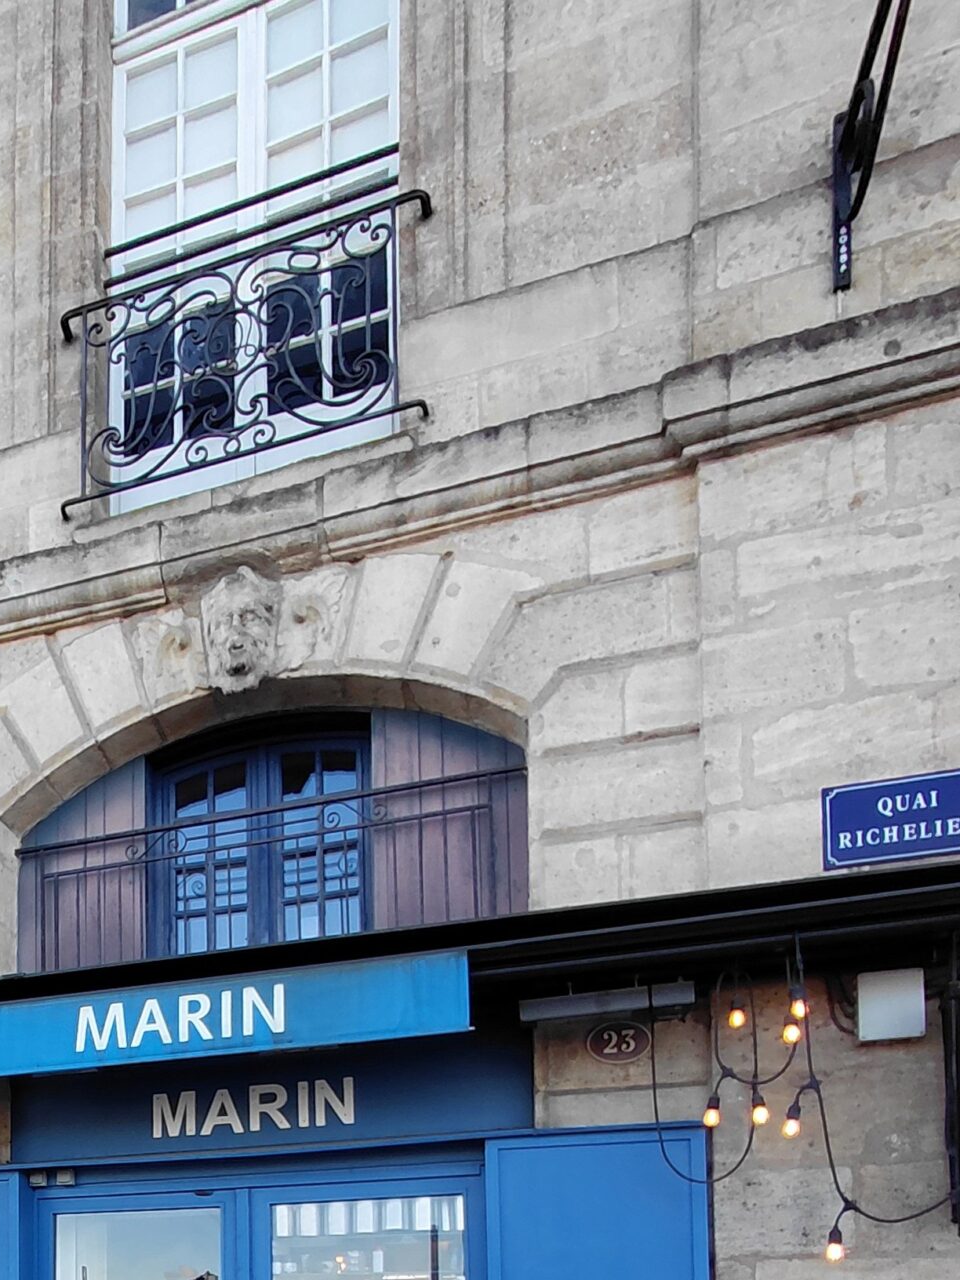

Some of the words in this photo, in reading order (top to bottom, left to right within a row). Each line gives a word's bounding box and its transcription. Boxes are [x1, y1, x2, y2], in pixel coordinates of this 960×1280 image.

[877, 790, 938, 817] QUAI
[74, 983, 285, 1053] MARIN
[602, 1029, 636, 1054] 23
[151, 1076, 355, 1139] MARIN
